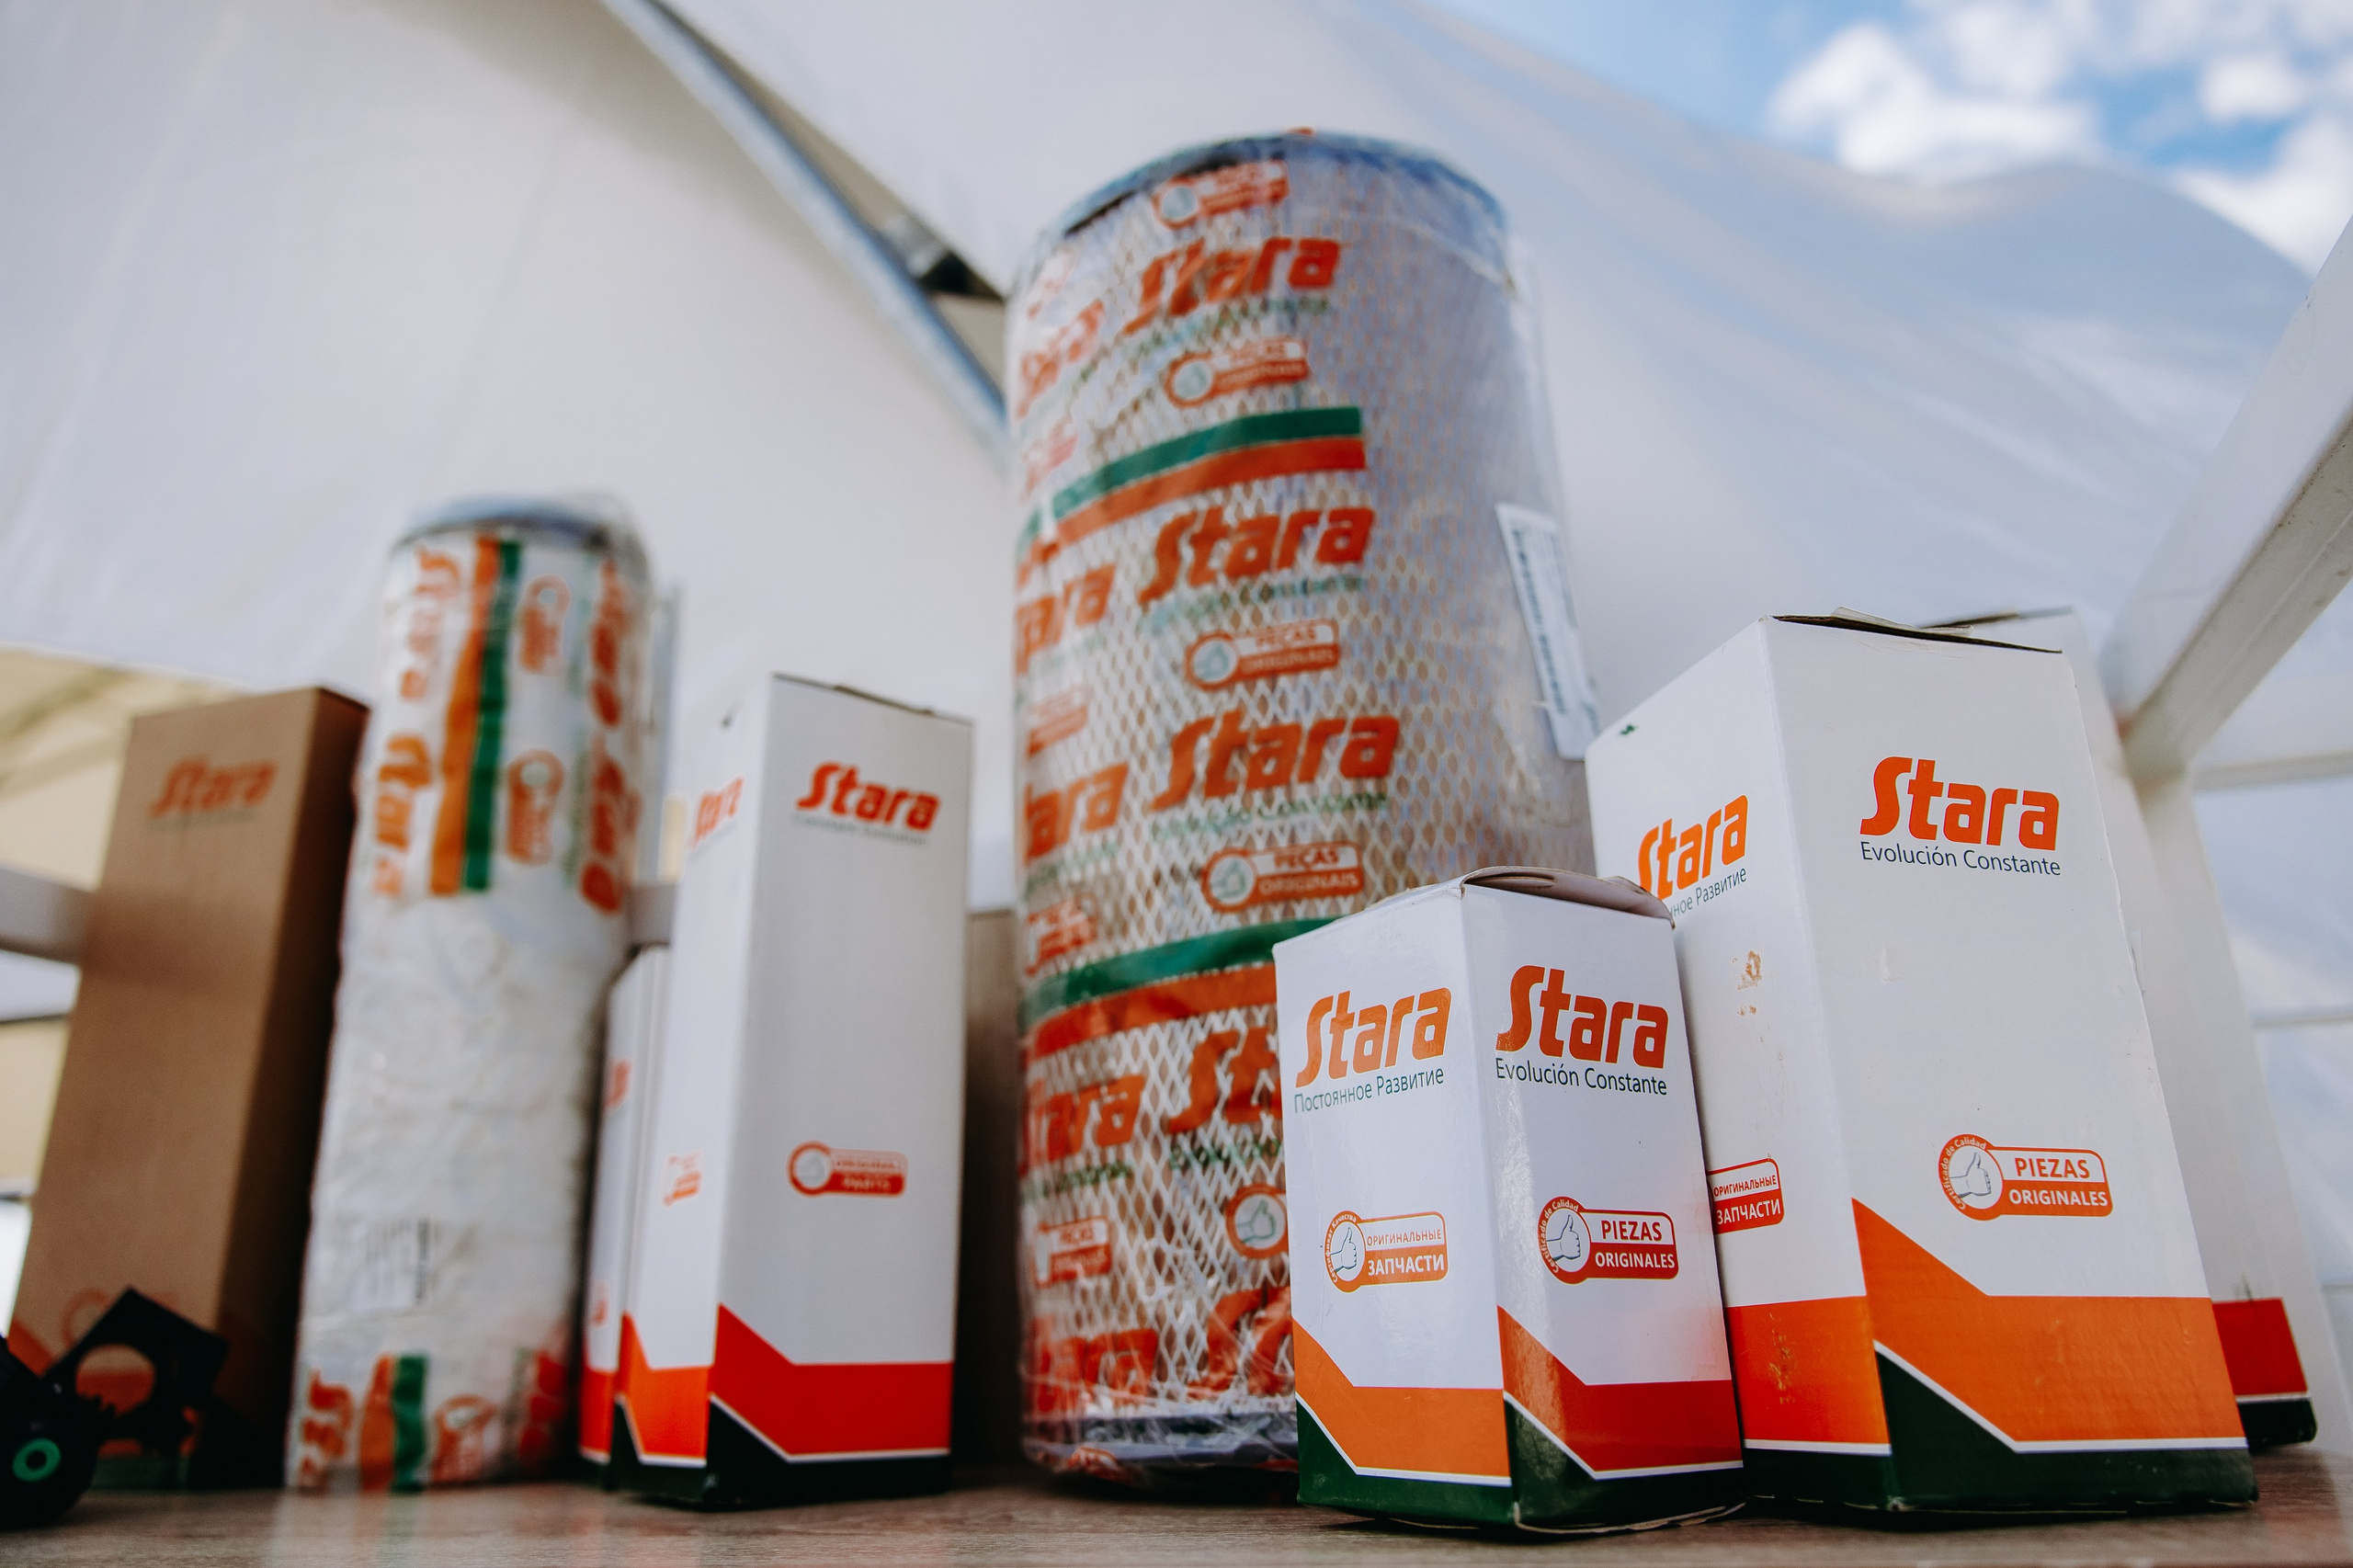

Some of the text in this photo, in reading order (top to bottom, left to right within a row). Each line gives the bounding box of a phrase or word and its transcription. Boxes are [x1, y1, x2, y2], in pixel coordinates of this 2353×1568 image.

[1122, 237, 1341, 335] Stara
[1137, 506, 1374, 607] Stara
[1151, 709, 1400, 812] Stara
[796, 762, 939, 832] Stara
[1859, 756, 2060, 851] Stara
[1638, 795, 1748, 901] Stara
[1860, 841, 2062, 876] Evolución Constante
[1696, 868, 1746, 905] Развитие
[1495, 965, 1668, 1069] Stara
[1295, 987, 1451, 1088] Stara
[1294, 1067, 1445, 1114] Постоянное Развитие
[1496, 1058, 1667, 1096] Evolución Constante
[1946, 1145, 1955, 1156] de
[1954, 1137, 1986, 1150] Calidad
[1713, 1175, 1777, 1197] ОРИГИНАЛЬНЫЕ
[2015, 1157, 2091, 1179] PIEZAS
[1716, 1199, 1781, 1225] ЗАПЧАСТИ
[2008, 1188, 2109, 1207] ORIGINALES
[1367, 1229, 1442, 1246] ОРИГИНАЛЬНЫЕ
[1539, 1199, 1579, 1273] Certificado de Calidad
[1601, 1220, 1662, 1241] PIEZAS
[1368, 1254, 1445, 1277] ЗАПЧАСТИ
[1595, 1252, 1676, 1268] ORIGINALES
